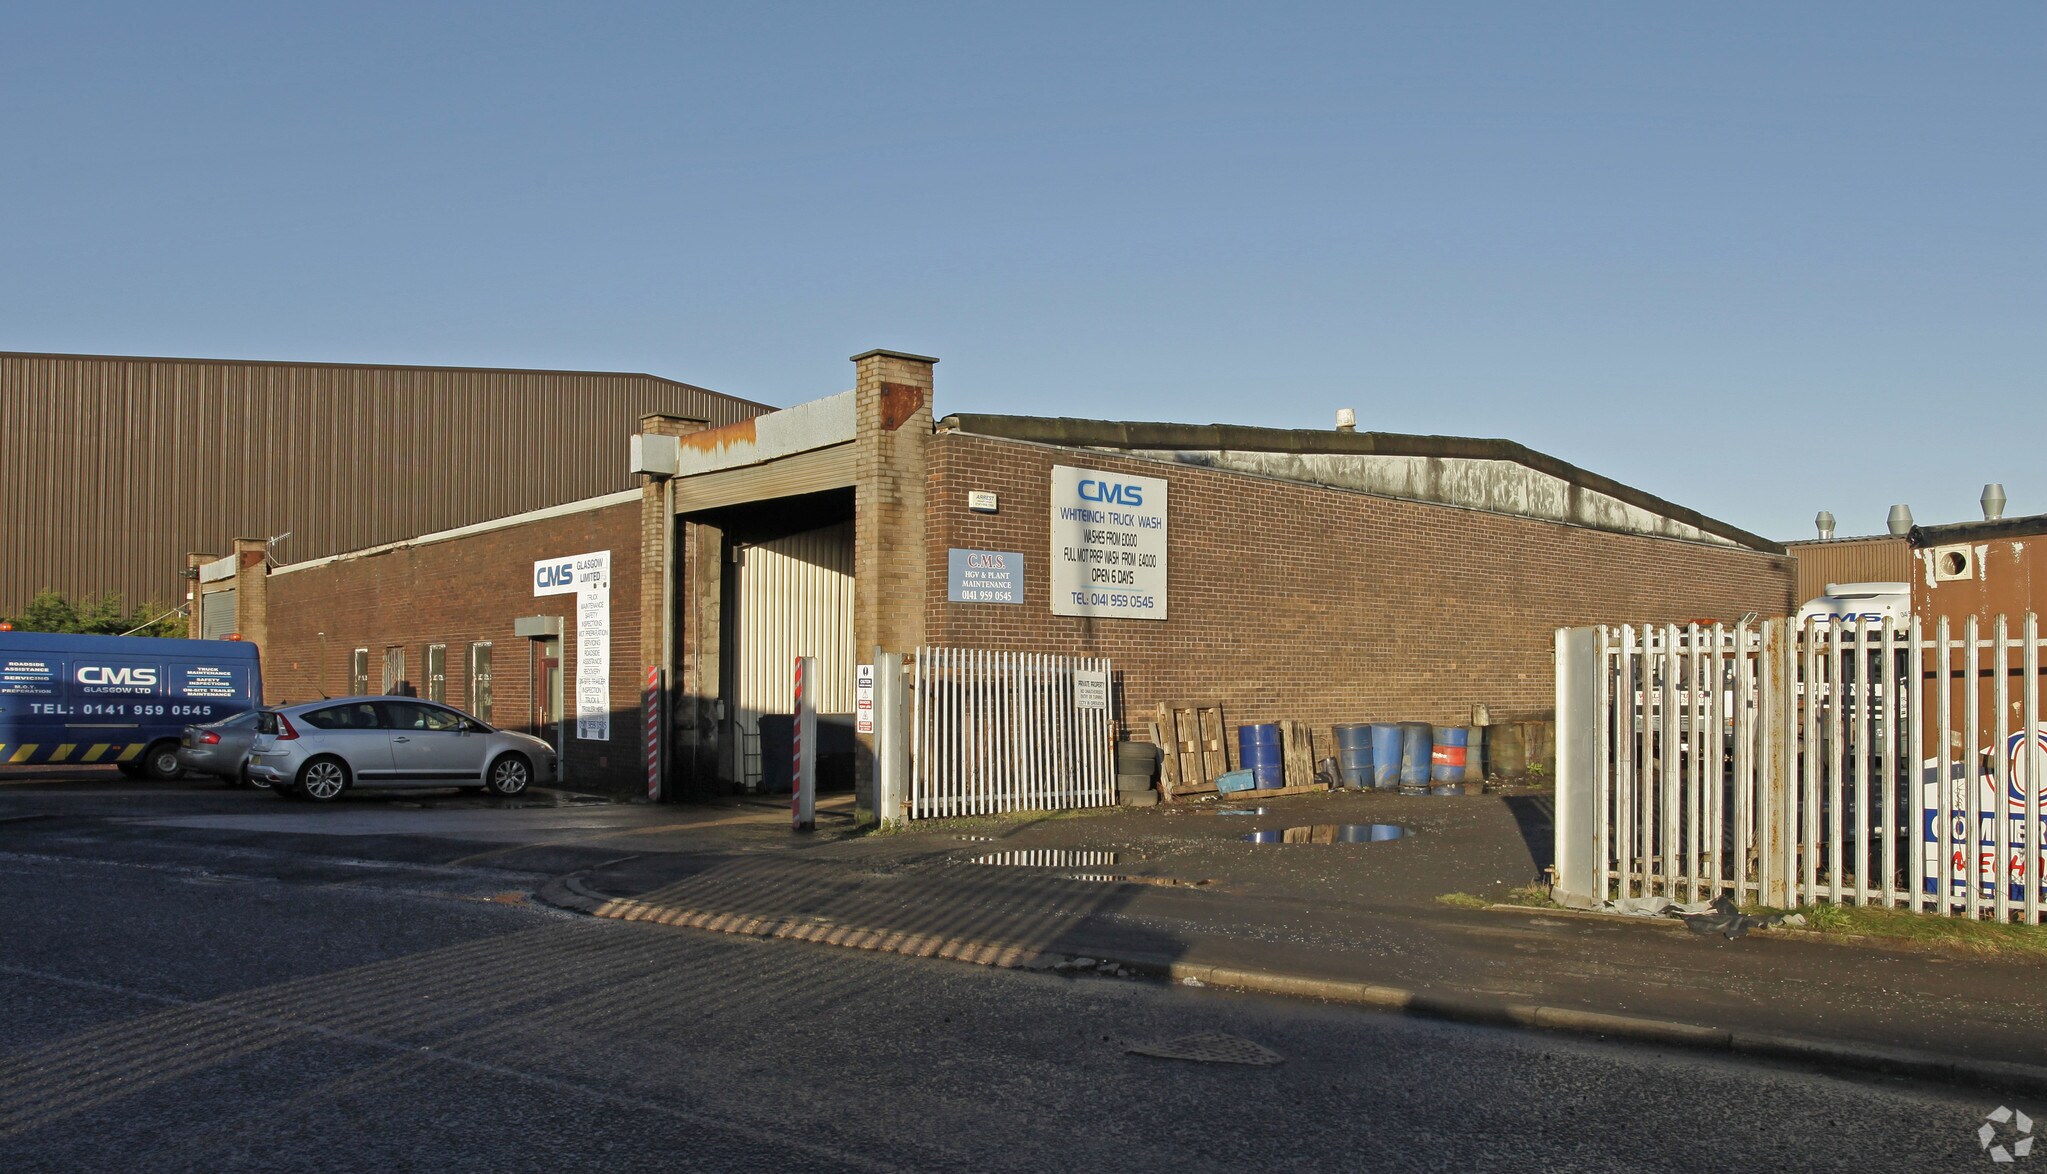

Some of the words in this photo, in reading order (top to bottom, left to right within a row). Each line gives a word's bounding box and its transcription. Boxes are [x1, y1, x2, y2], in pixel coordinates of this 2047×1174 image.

[1077, 479, 1143, 507] CMS
[1060, 507, 1105, 524] WHITEINCH
[1108, 512, 1134, 527] TRUCK
[1138, 515, 1162, 530] WASH
[1083, 529, 1105, 545] WASHES
[1106, 531, 1121, 546] FROM
[576, 558, 604, 570] GLASGOW
[968, 553, 1006, 569] C.M.S.
[1063, 547, 1076, 562] FULL
[1077, 547, 1089, 563] MOT
[1089, 548, 1103, 564] PREP
[1104, 550, 1119, 565] WASH
[1121, 552, 1136, 566] FROM
[536, 563, 573, 588] CMS
[580, 571, 600, 583] LIMITED
[965, 571, 980, 579] HGV
[988, 572, 1010, 580] PLANT
[1091, 568, 1110, 583] OPEN
[1111, 569, 1116, 583] 6
[1117, 571, 1134, 585] DAYS
[962, 580, 1012, 589] MAINTENANCE
[962, 590, 977, 600] 0141
[980, 591, 993, 600] 959
[995, 591, 1012, 601] 0545
[1071, 591, 1089, 605] TEL:
[1091, 593, 1109, 606] 0141
[1111, 594, 1128, 607] 959
[1130, 595, 1154, 608] 0545
[1807, 612, 1882, 622] CMS
[77, 666, 157, 686] CMS
[83, 686, 132, 694] GLASGOW
[134, 686, 151, 694] LTD
[30, 703, 75, 714] TEL:
[83, 704, 125, 715] 0141
[134, 704, 164, 715] 959
[171, 704, 212, 716] 0545
